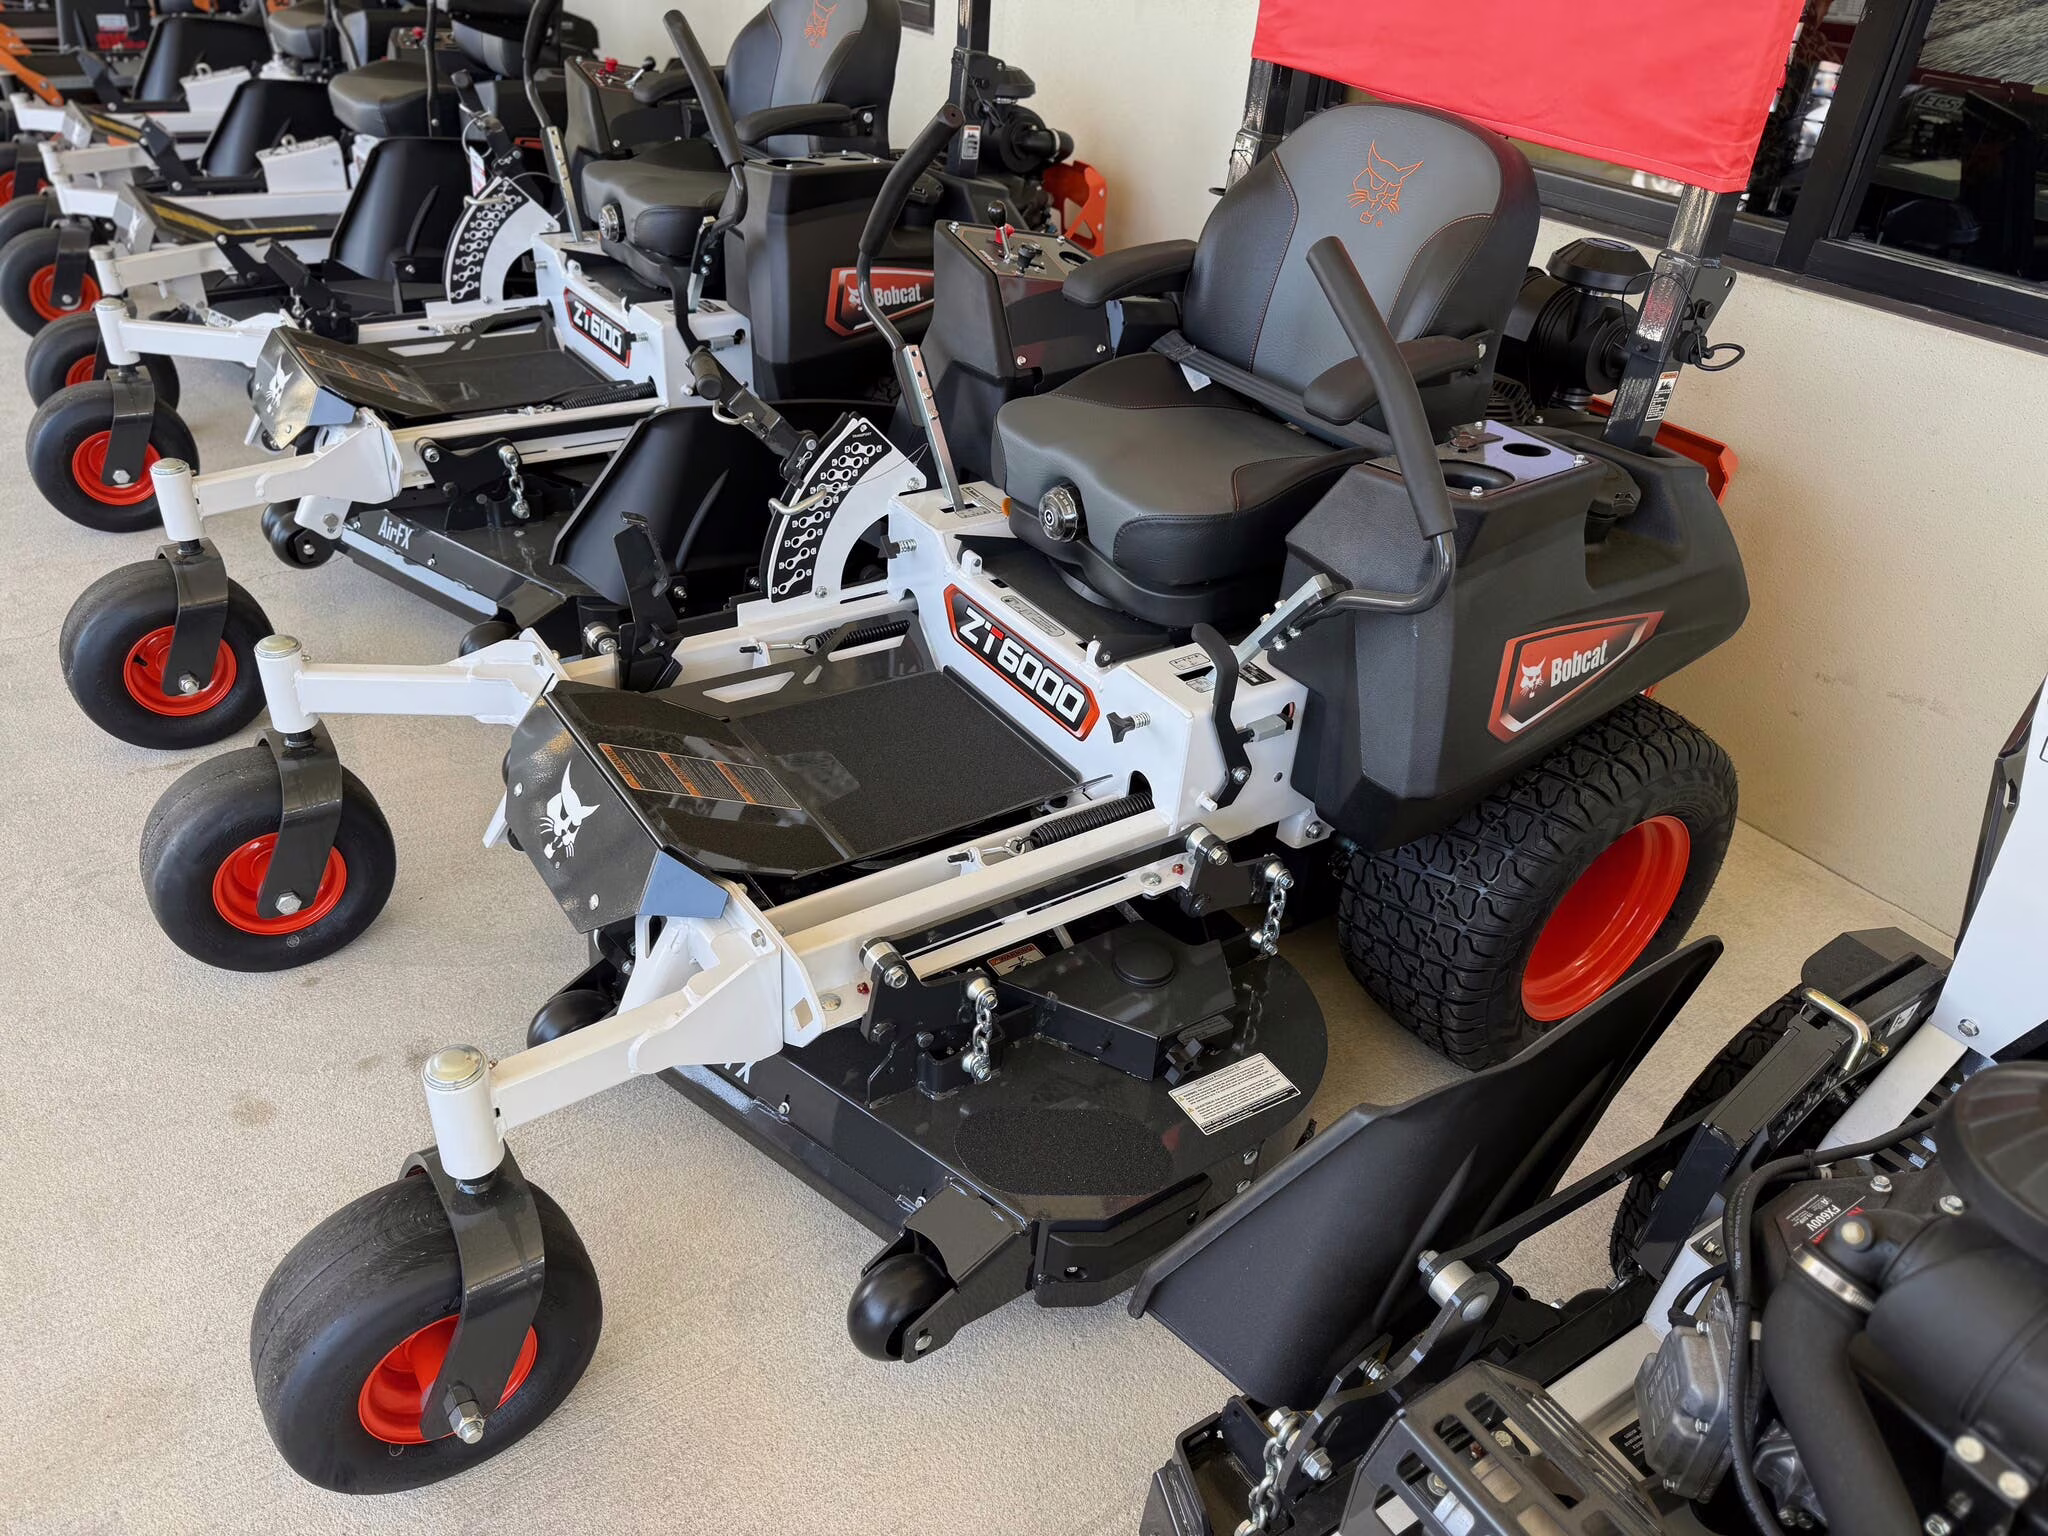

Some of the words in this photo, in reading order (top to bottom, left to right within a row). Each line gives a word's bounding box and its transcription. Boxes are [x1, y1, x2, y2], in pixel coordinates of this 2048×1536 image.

[873, 283, 922, 307] Bobcat
[572, 300, 623, 356] ZT6100
[377, 515, 416, 550] AirFX
[958, 606, 1087, 724] ZT6000
[1550, 639, 1609, 688] Bobcat
[1806, 1203, 1842, 1232] FX600V
